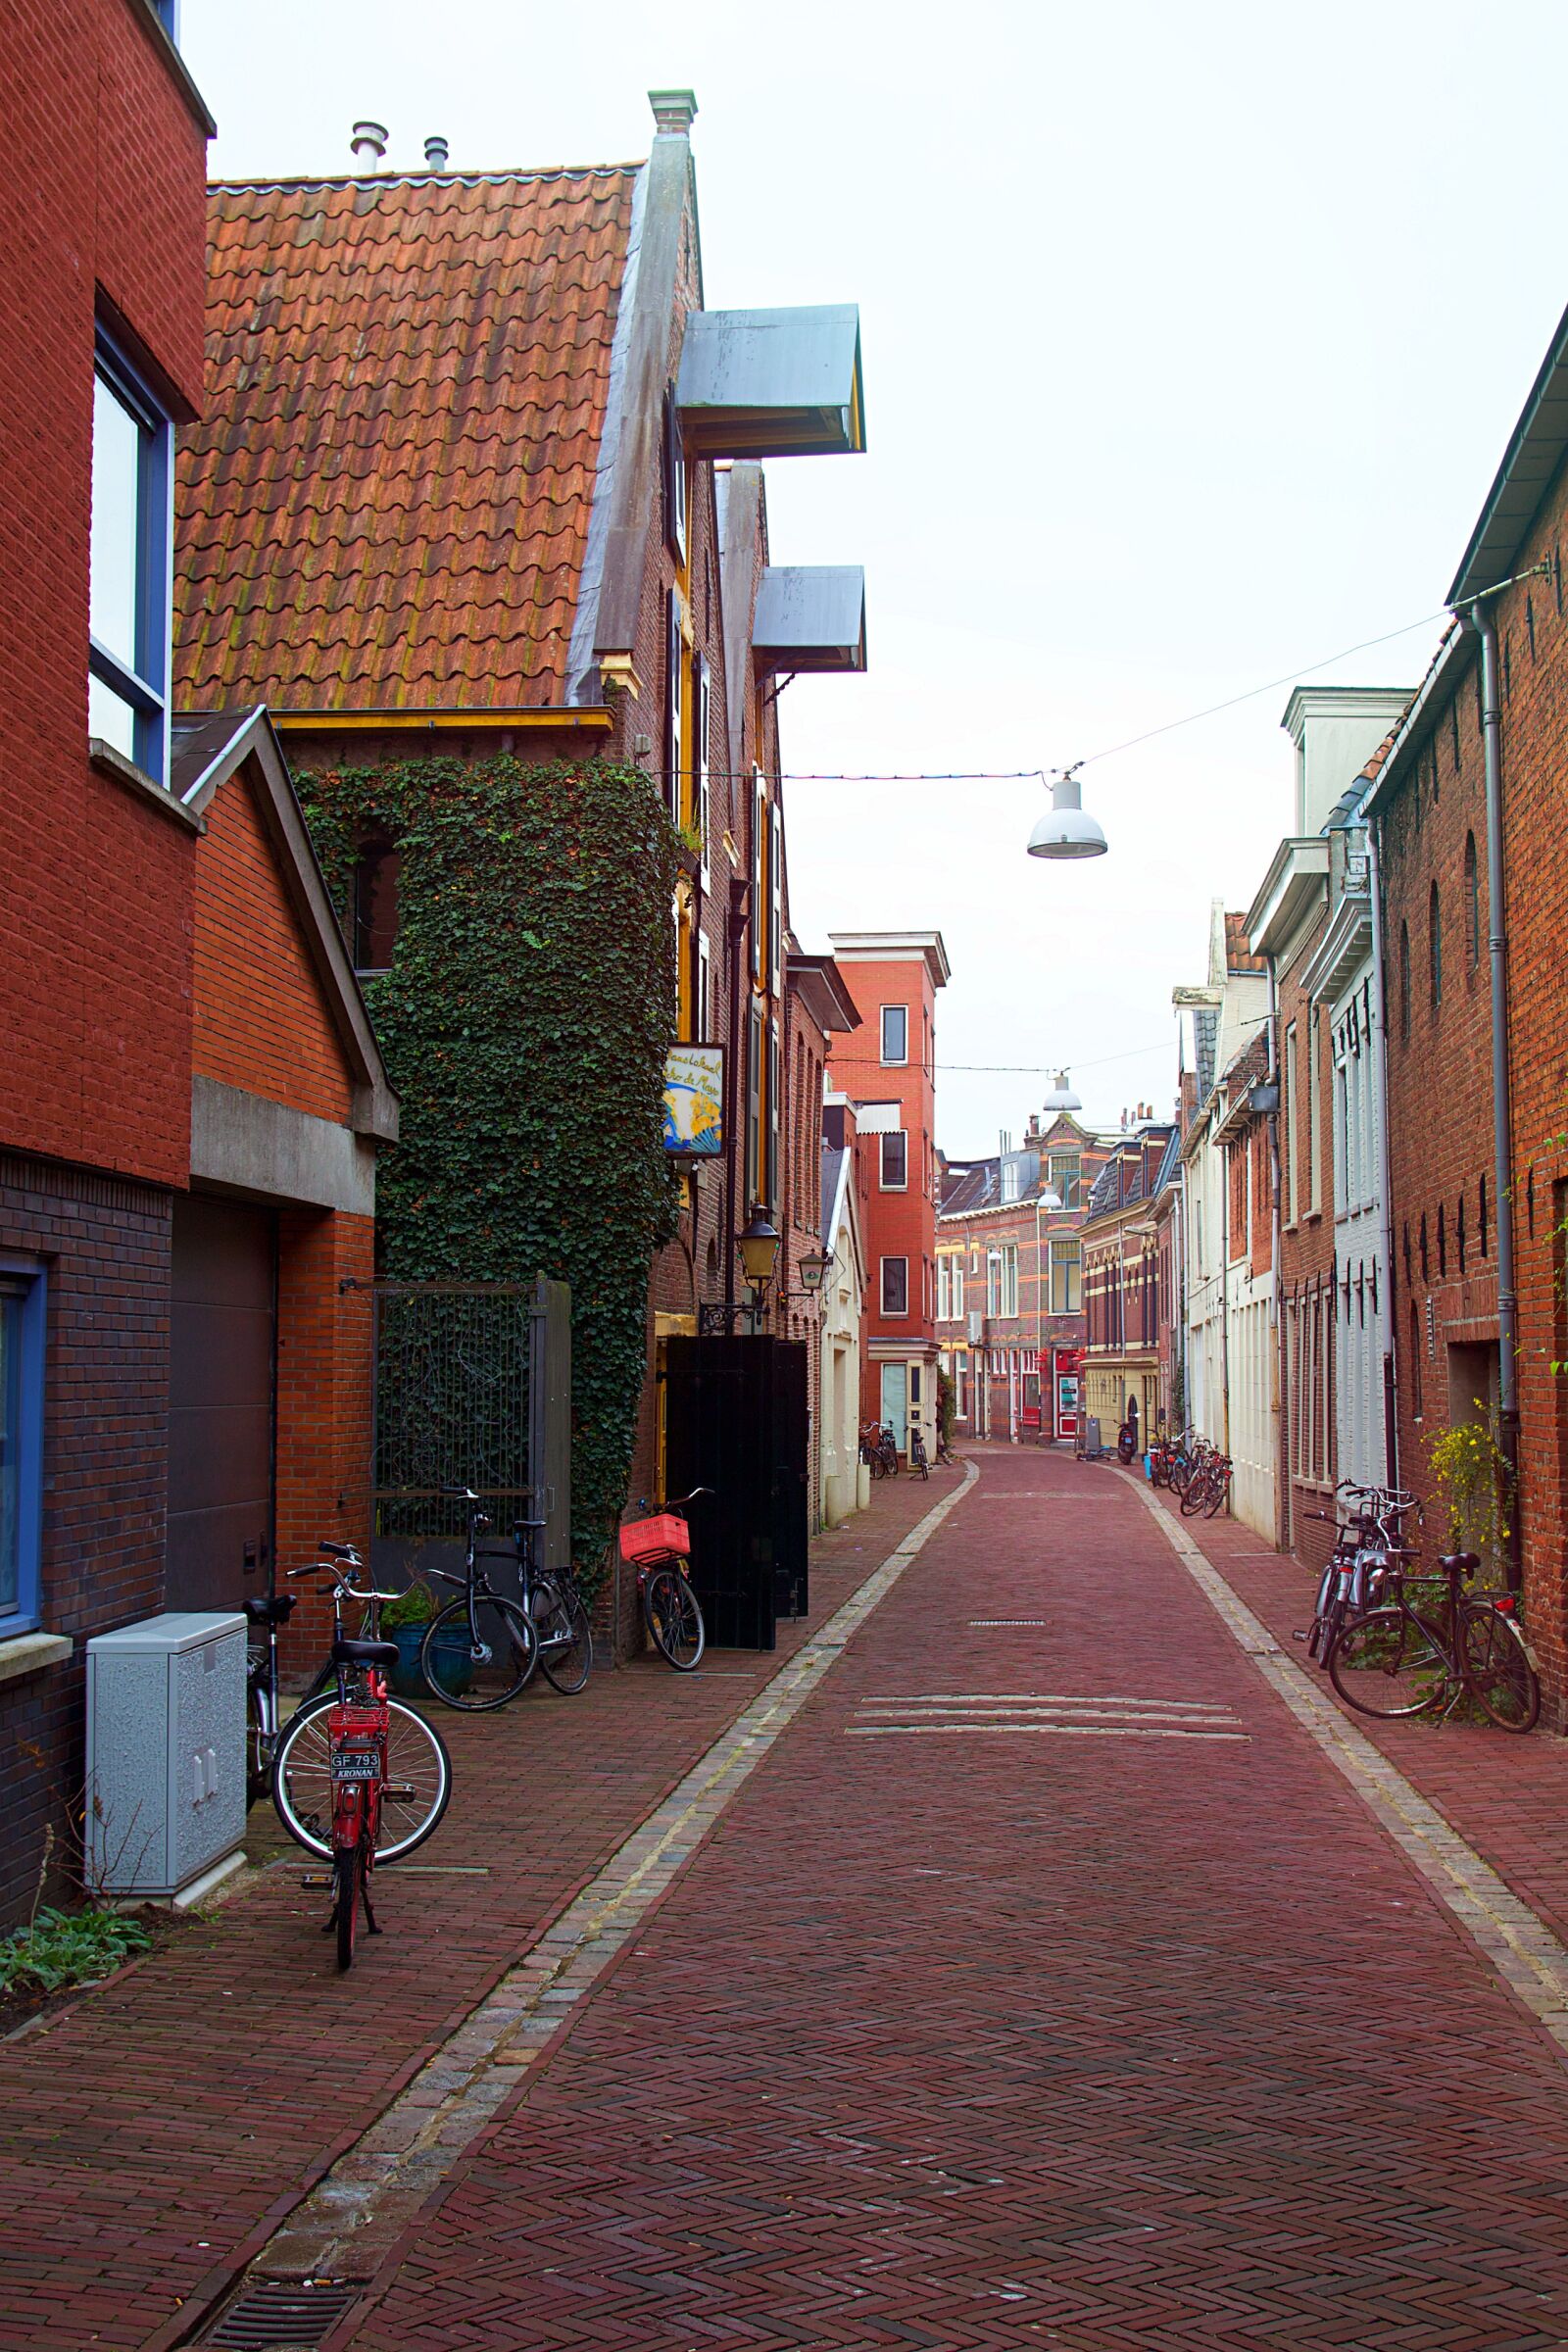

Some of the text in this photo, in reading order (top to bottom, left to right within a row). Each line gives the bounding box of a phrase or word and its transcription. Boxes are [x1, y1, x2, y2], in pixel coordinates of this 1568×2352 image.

[684, 1072, 695, 1085] de
[332, 1754, 378, 1767] GF 793
[337, 1769, 373, 1778] KRONAN
